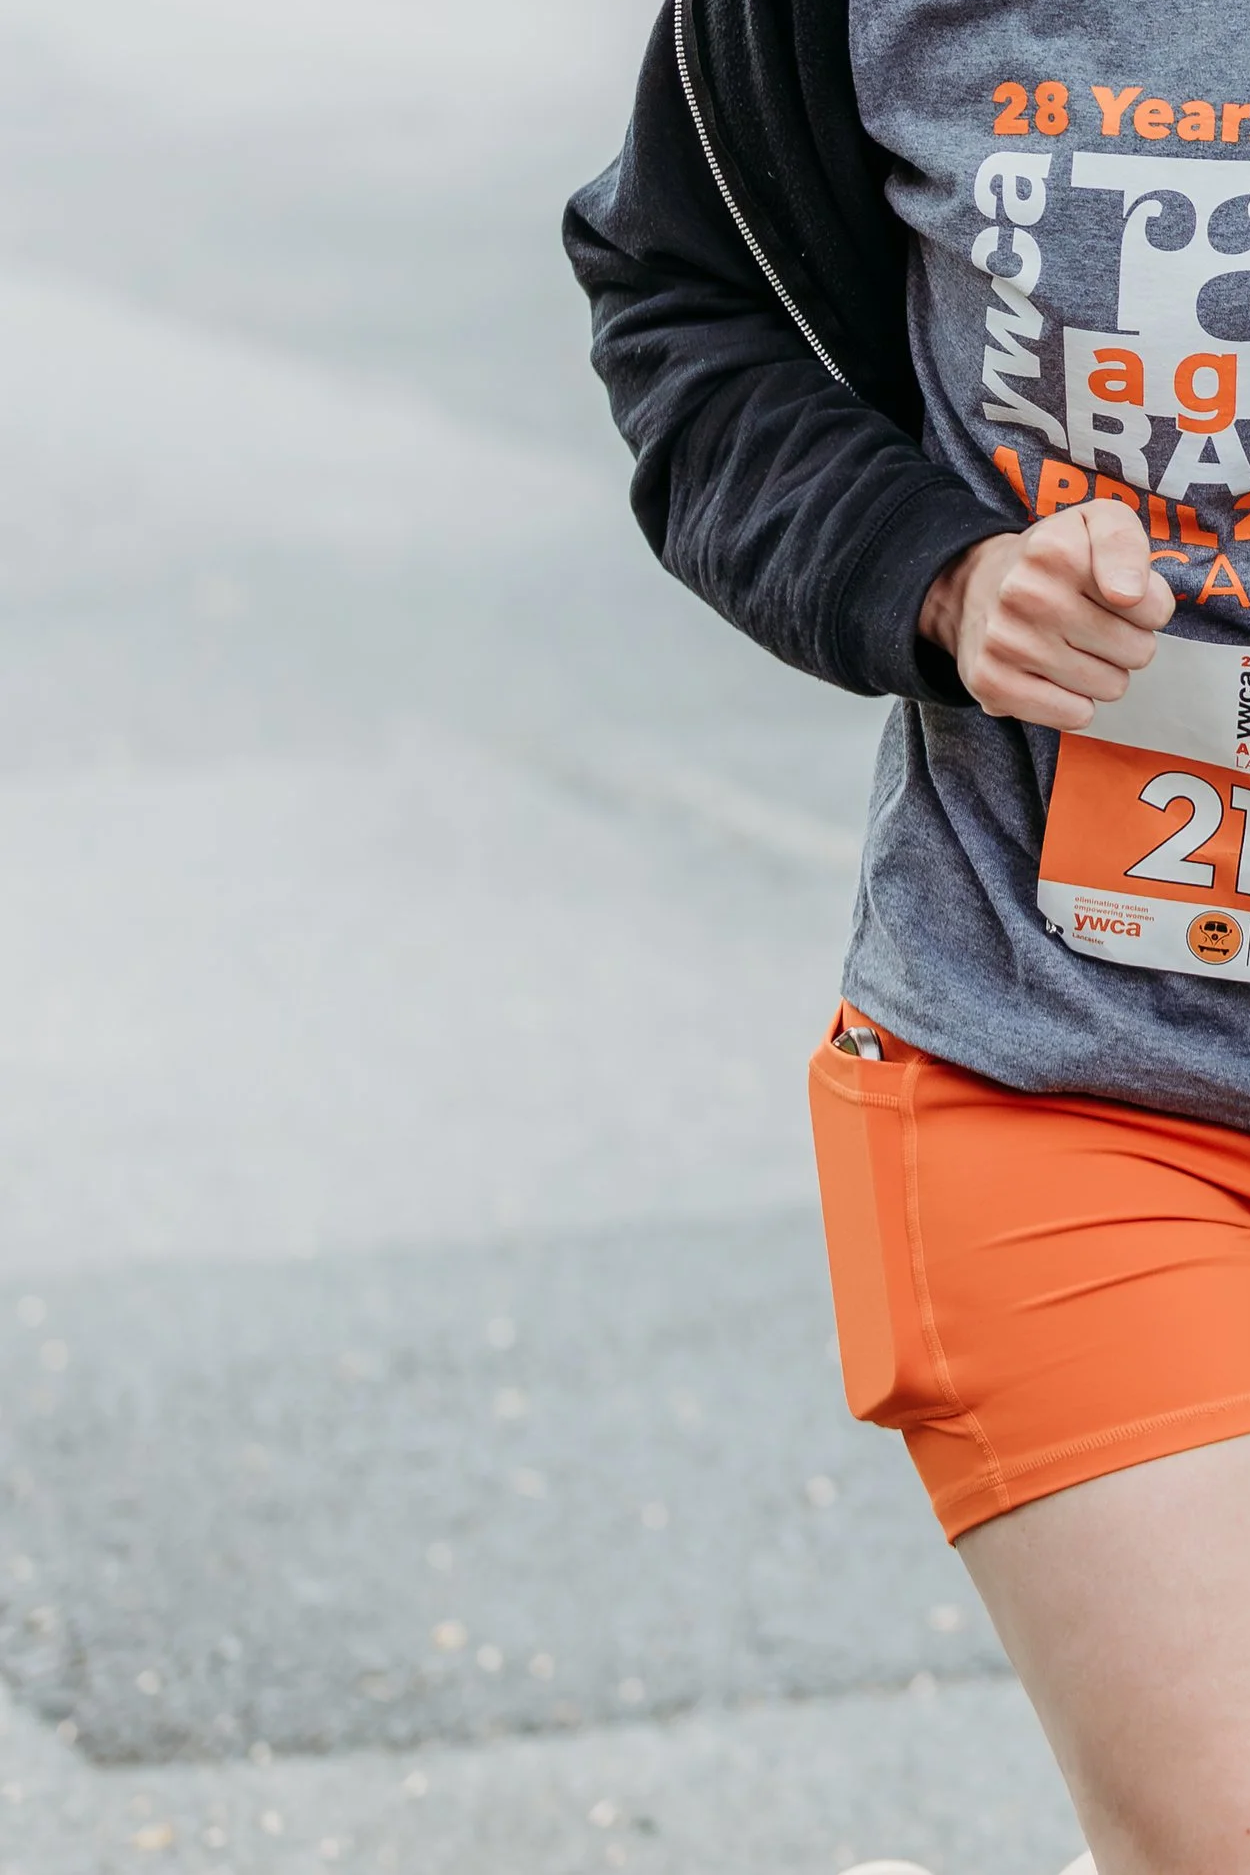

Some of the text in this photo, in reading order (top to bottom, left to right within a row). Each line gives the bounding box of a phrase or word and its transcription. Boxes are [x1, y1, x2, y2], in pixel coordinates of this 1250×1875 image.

[992, 81, 1070, 136] 28
[972, 150, 1069, 450] ywca
[1074, 896, 1149, 913] eliminating racism
[1074, 904, 1155, 922] empowering women
[1074, 912, 1142, 938] ywca
[1072, 932, 1105, 945] Lancaster
